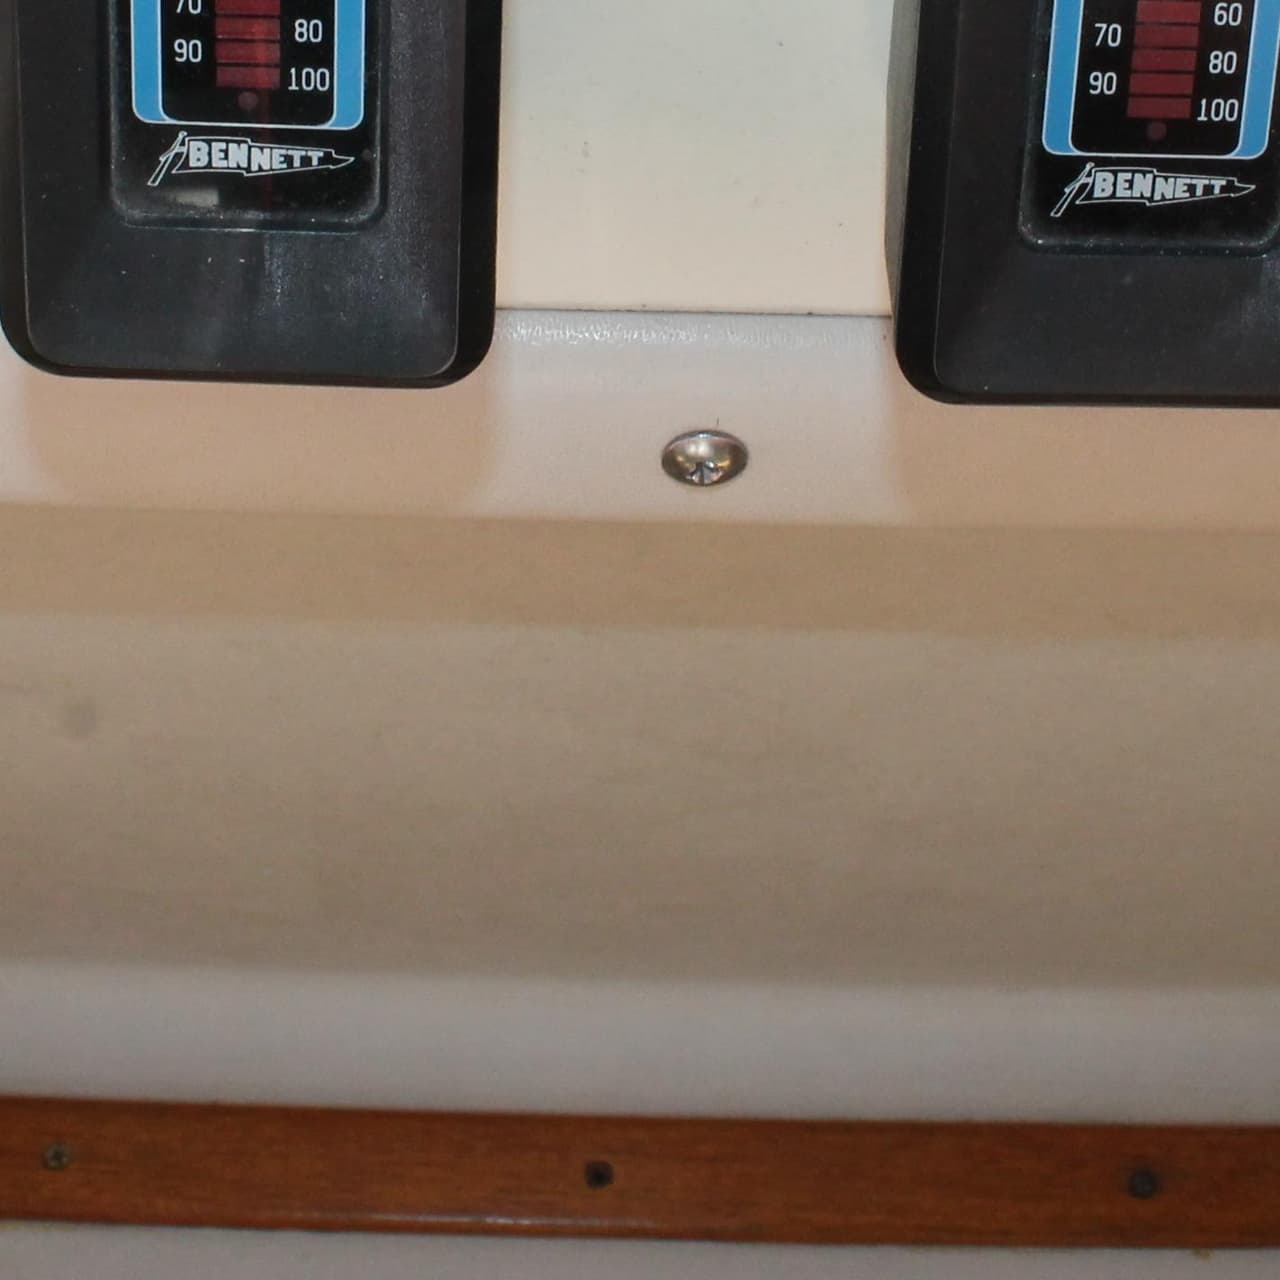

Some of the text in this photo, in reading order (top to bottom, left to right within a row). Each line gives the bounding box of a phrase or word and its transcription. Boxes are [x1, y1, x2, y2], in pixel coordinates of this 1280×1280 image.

[1213, 2, 1243, 27] 60
[294, 19, 323, 43] 80
[1094, 23, 1122, 48] 70
[173, 39, 203, 63] 90
[1208, 51, 1238, 75] 80
[287, 67, 330, 92] 100
[1089, 71, 1117, 95] 90
[1196, 98, 1239, 122] 100
[188, 140, 325, 172] BENNETT
[1093, 170, 1227, 201] BENNETT
